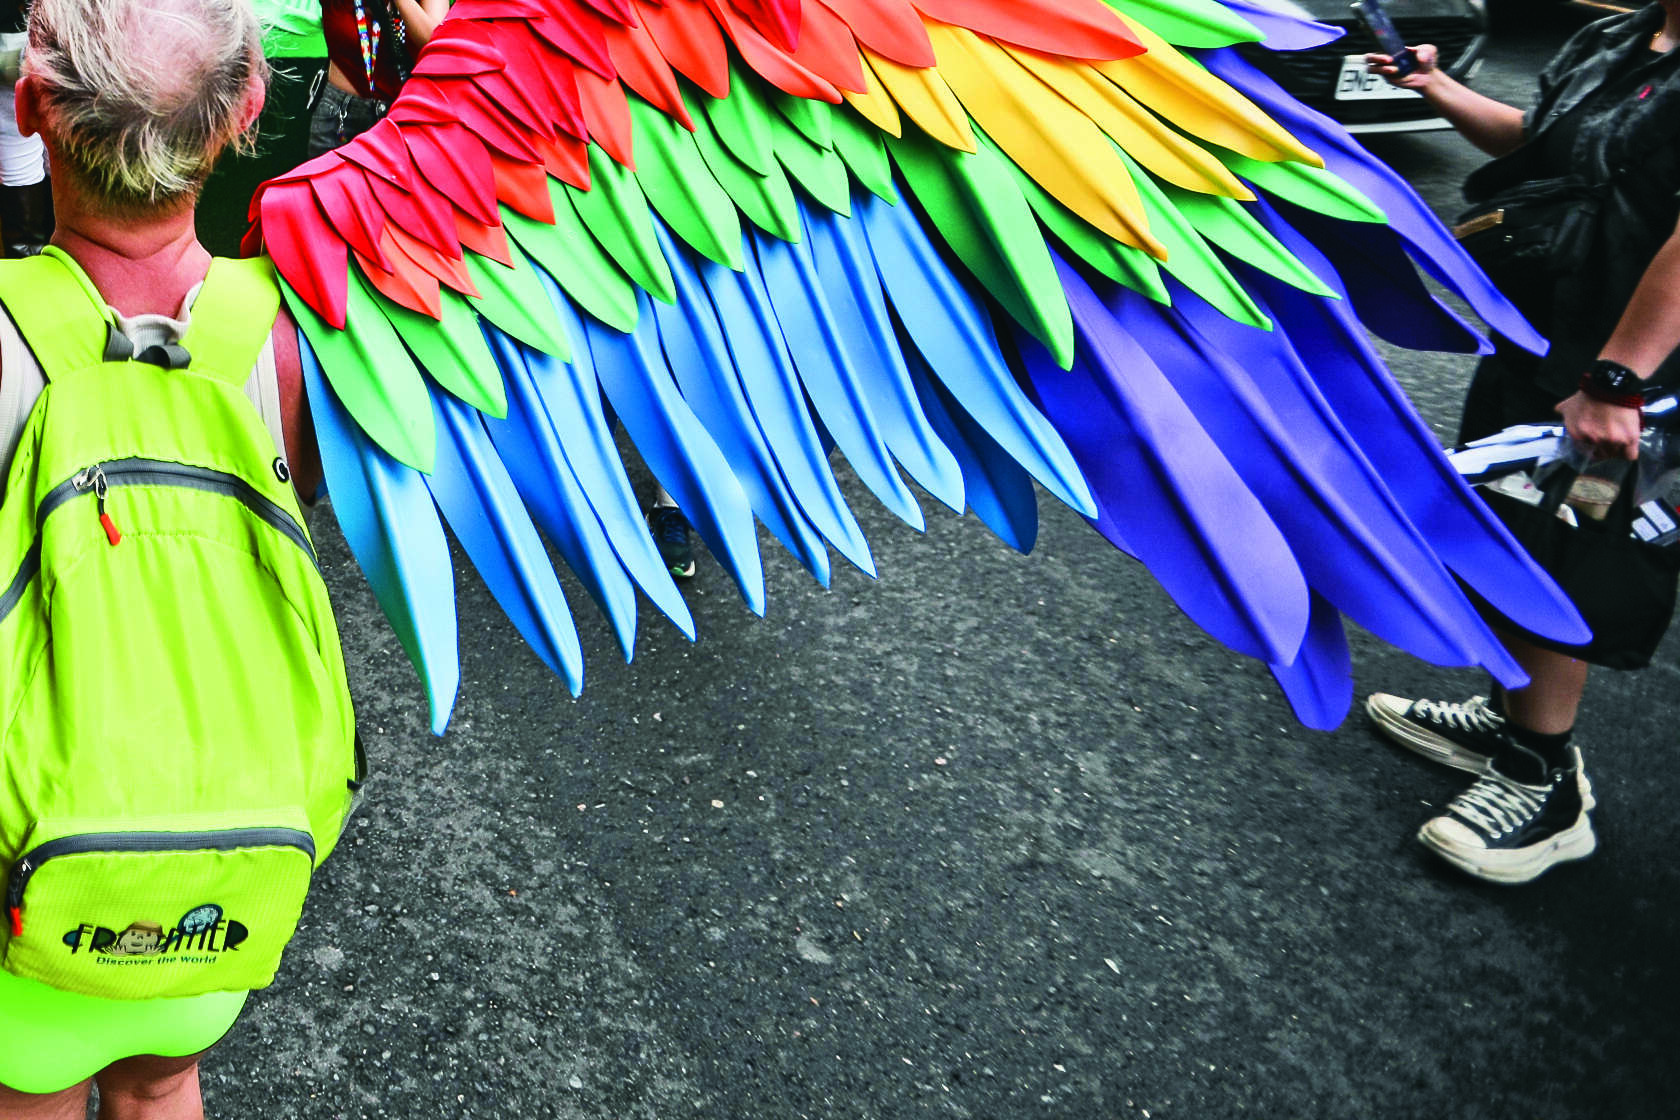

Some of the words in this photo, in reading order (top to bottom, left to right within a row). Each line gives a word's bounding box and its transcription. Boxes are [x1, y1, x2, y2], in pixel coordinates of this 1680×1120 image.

[96, 956, 152, 966] Discover
[158, 955, 176, 965] the
[180, 956, 217, 965] World
